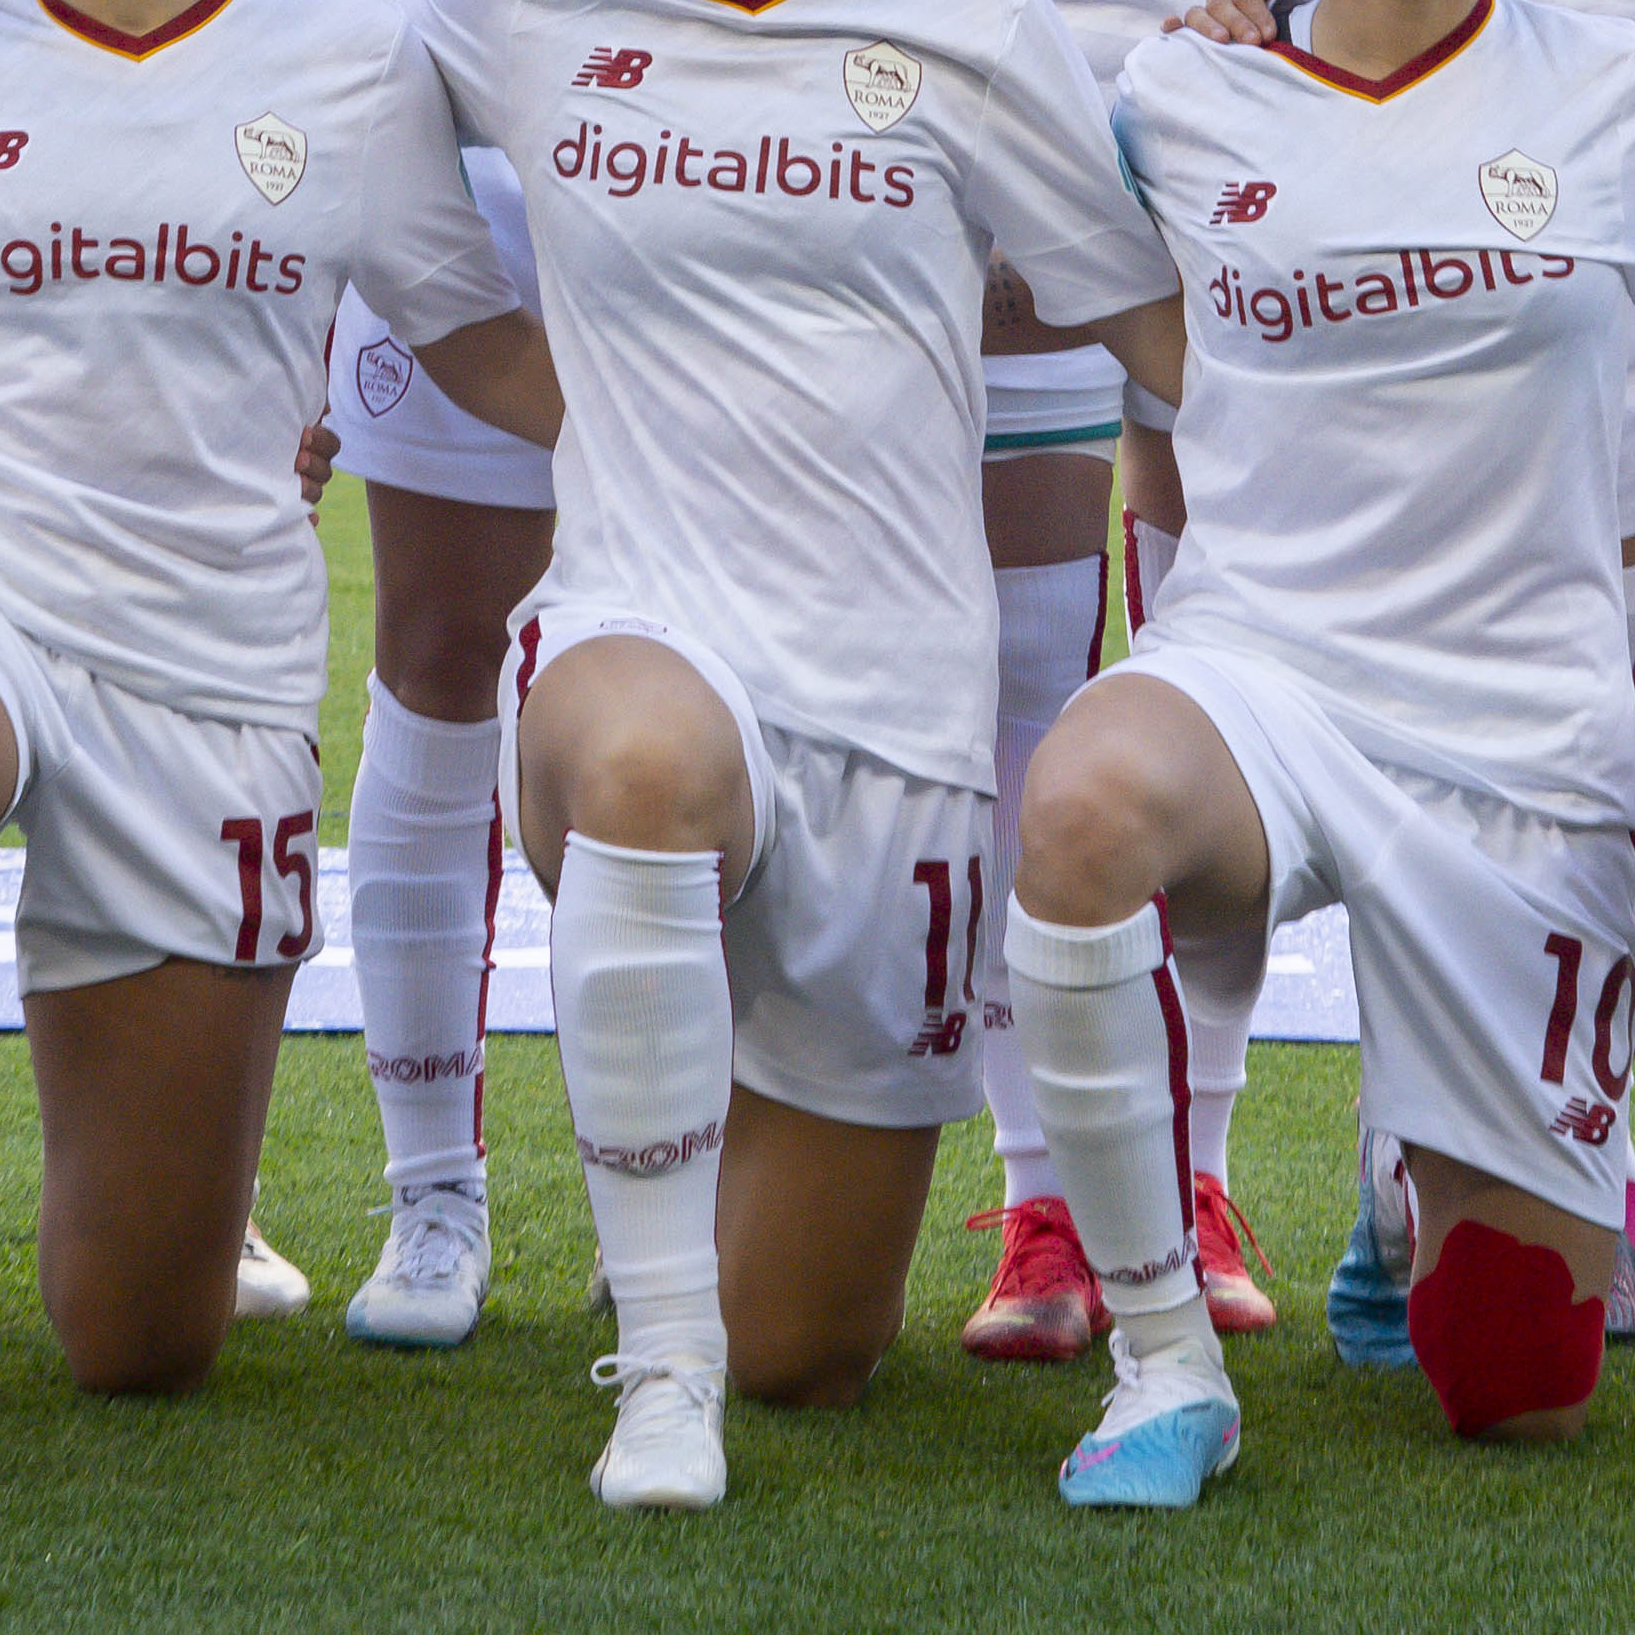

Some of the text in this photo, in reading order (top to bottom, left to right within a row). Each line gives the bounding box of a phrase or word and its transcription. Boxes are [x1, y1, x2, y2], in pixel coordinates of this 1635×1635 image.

[853, 88, 906, 110] ROMA
[250, 161, 298, 180] ROMA
[552, 121, 915, 208] digitalbits
[1495, 200, 1549, 216] ROMA
[221, 810, 316, 962] 15
